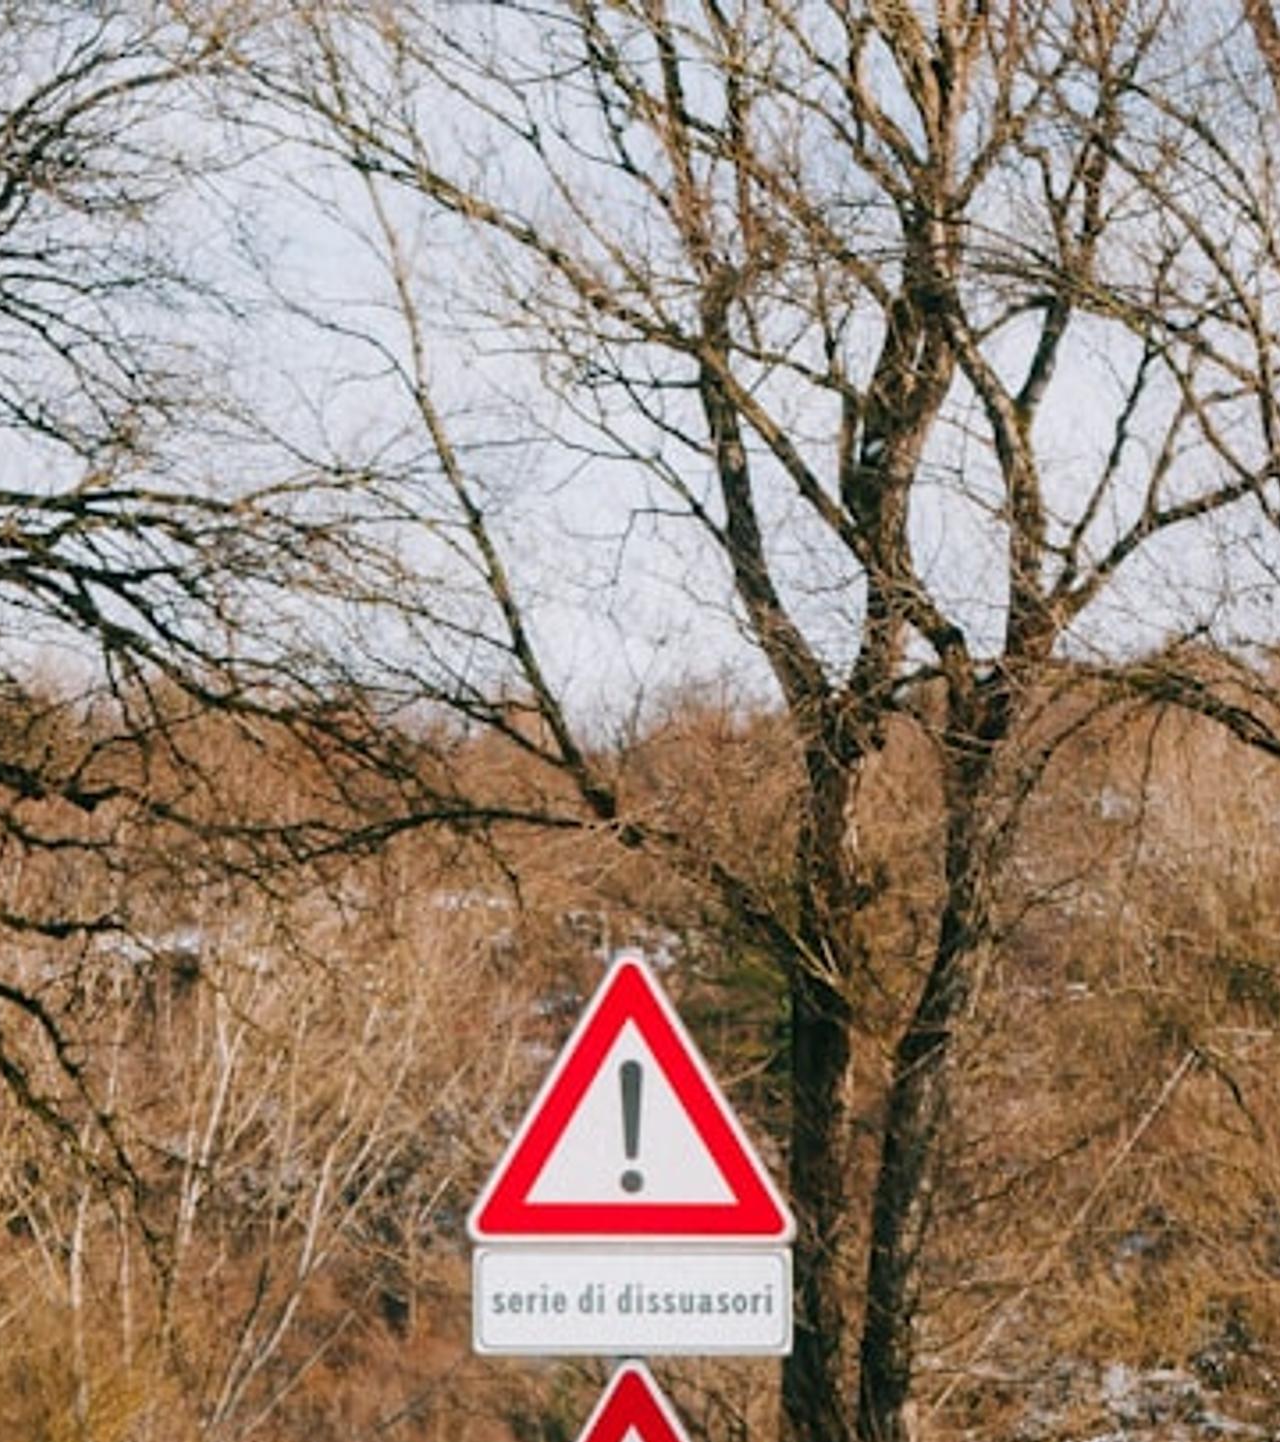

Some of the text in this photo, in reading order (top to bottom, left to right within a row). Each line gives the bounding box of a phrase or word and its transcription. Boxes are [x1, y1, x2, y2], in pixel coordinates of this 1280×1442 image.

[492, 1284, 773, 1314] serie di dissuasori
